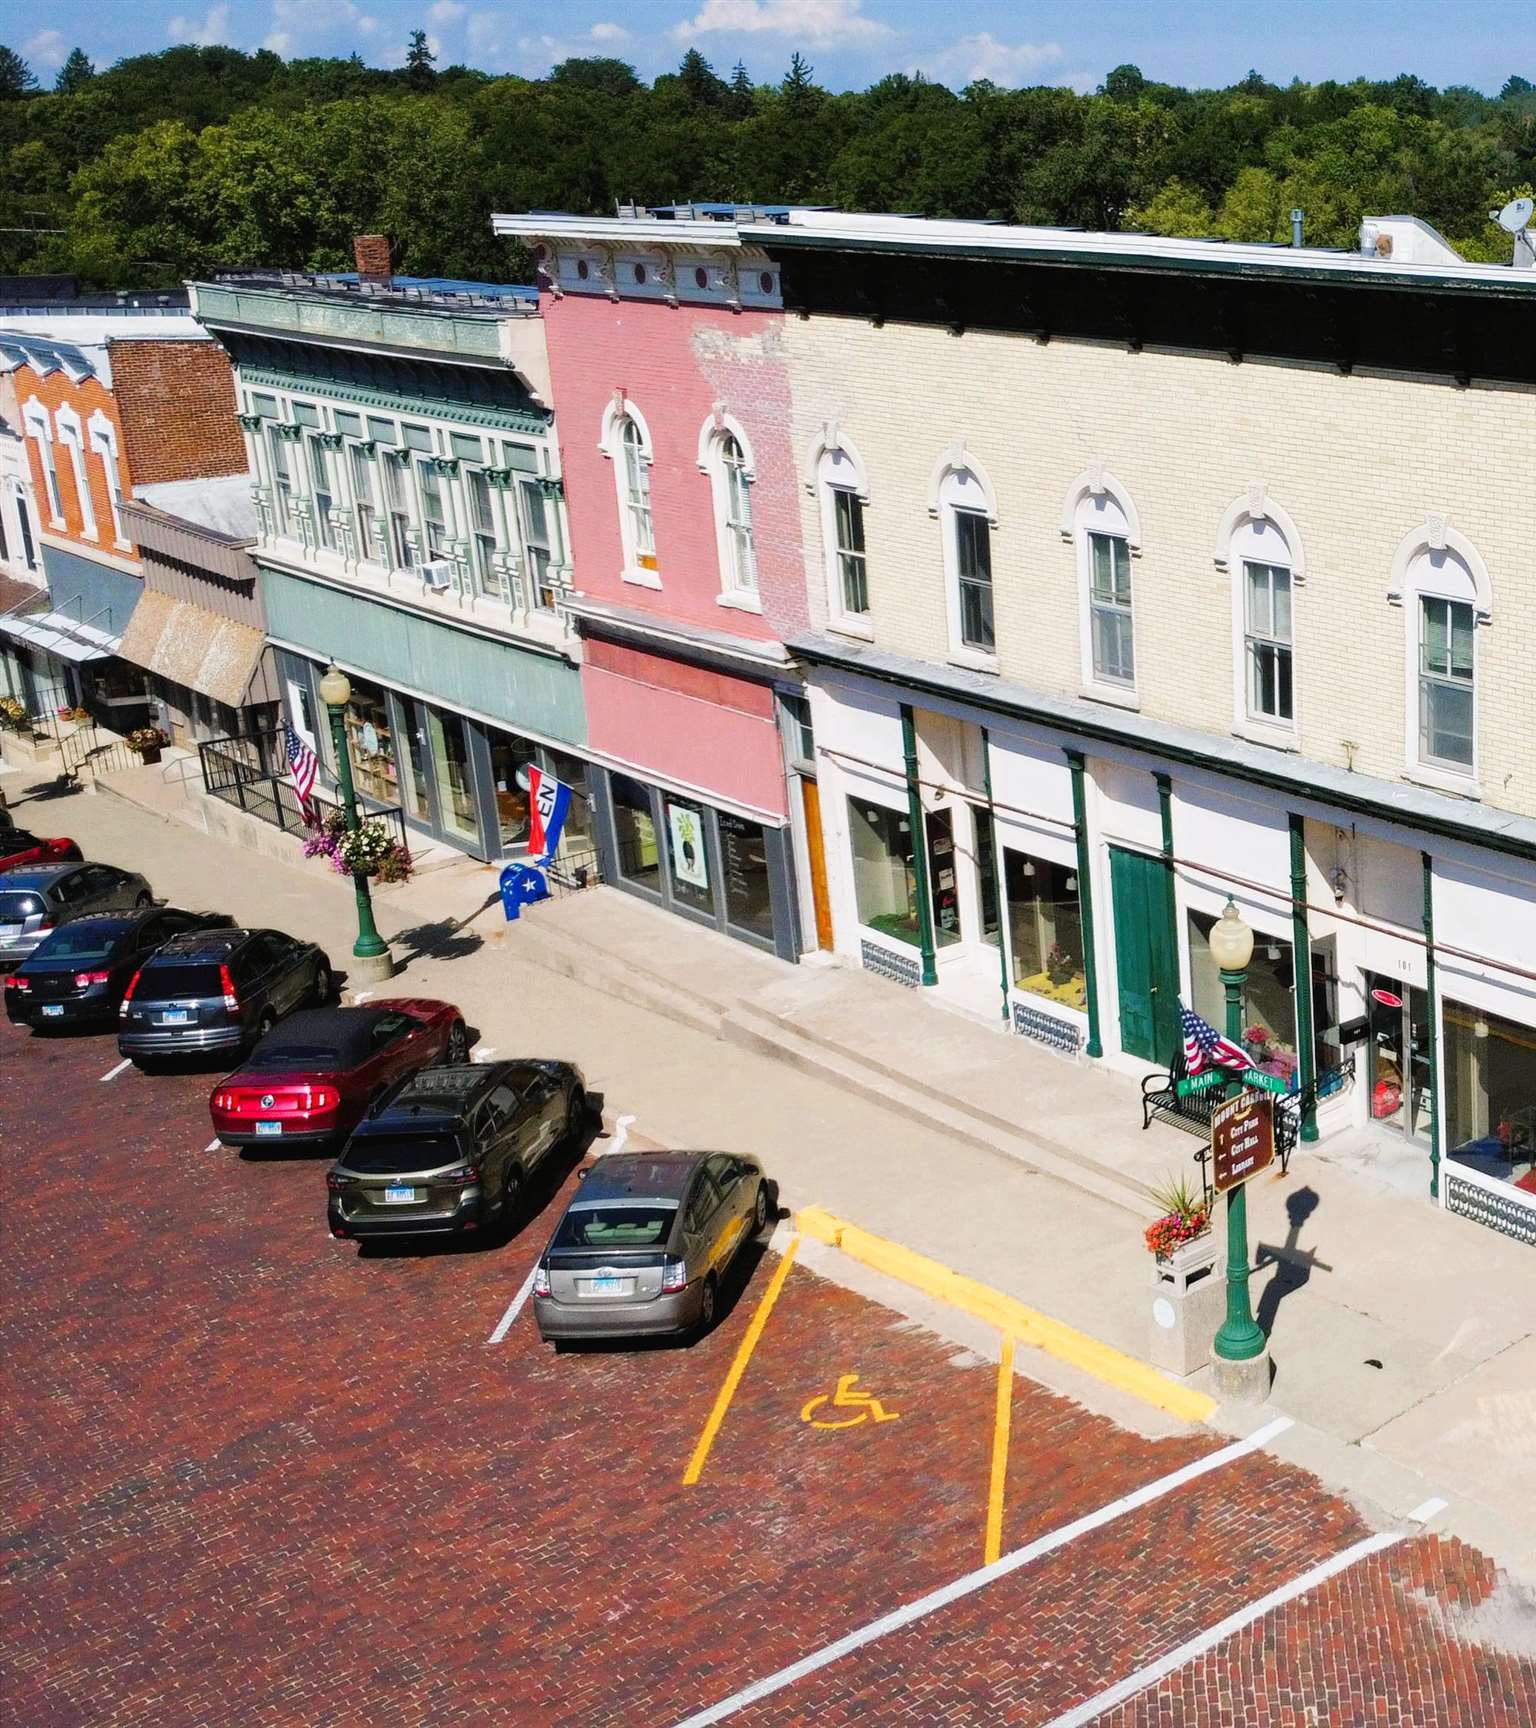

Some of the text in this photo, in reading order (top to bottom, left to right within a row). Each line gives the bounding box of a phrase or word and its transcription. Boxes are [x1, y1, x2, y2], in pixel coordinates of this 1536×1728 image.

[536, 784, 555, 818] EN
[1190, 1072, 1214, 1089] MAIN
[1214, 1102, 1240, 1128] MOUNT
